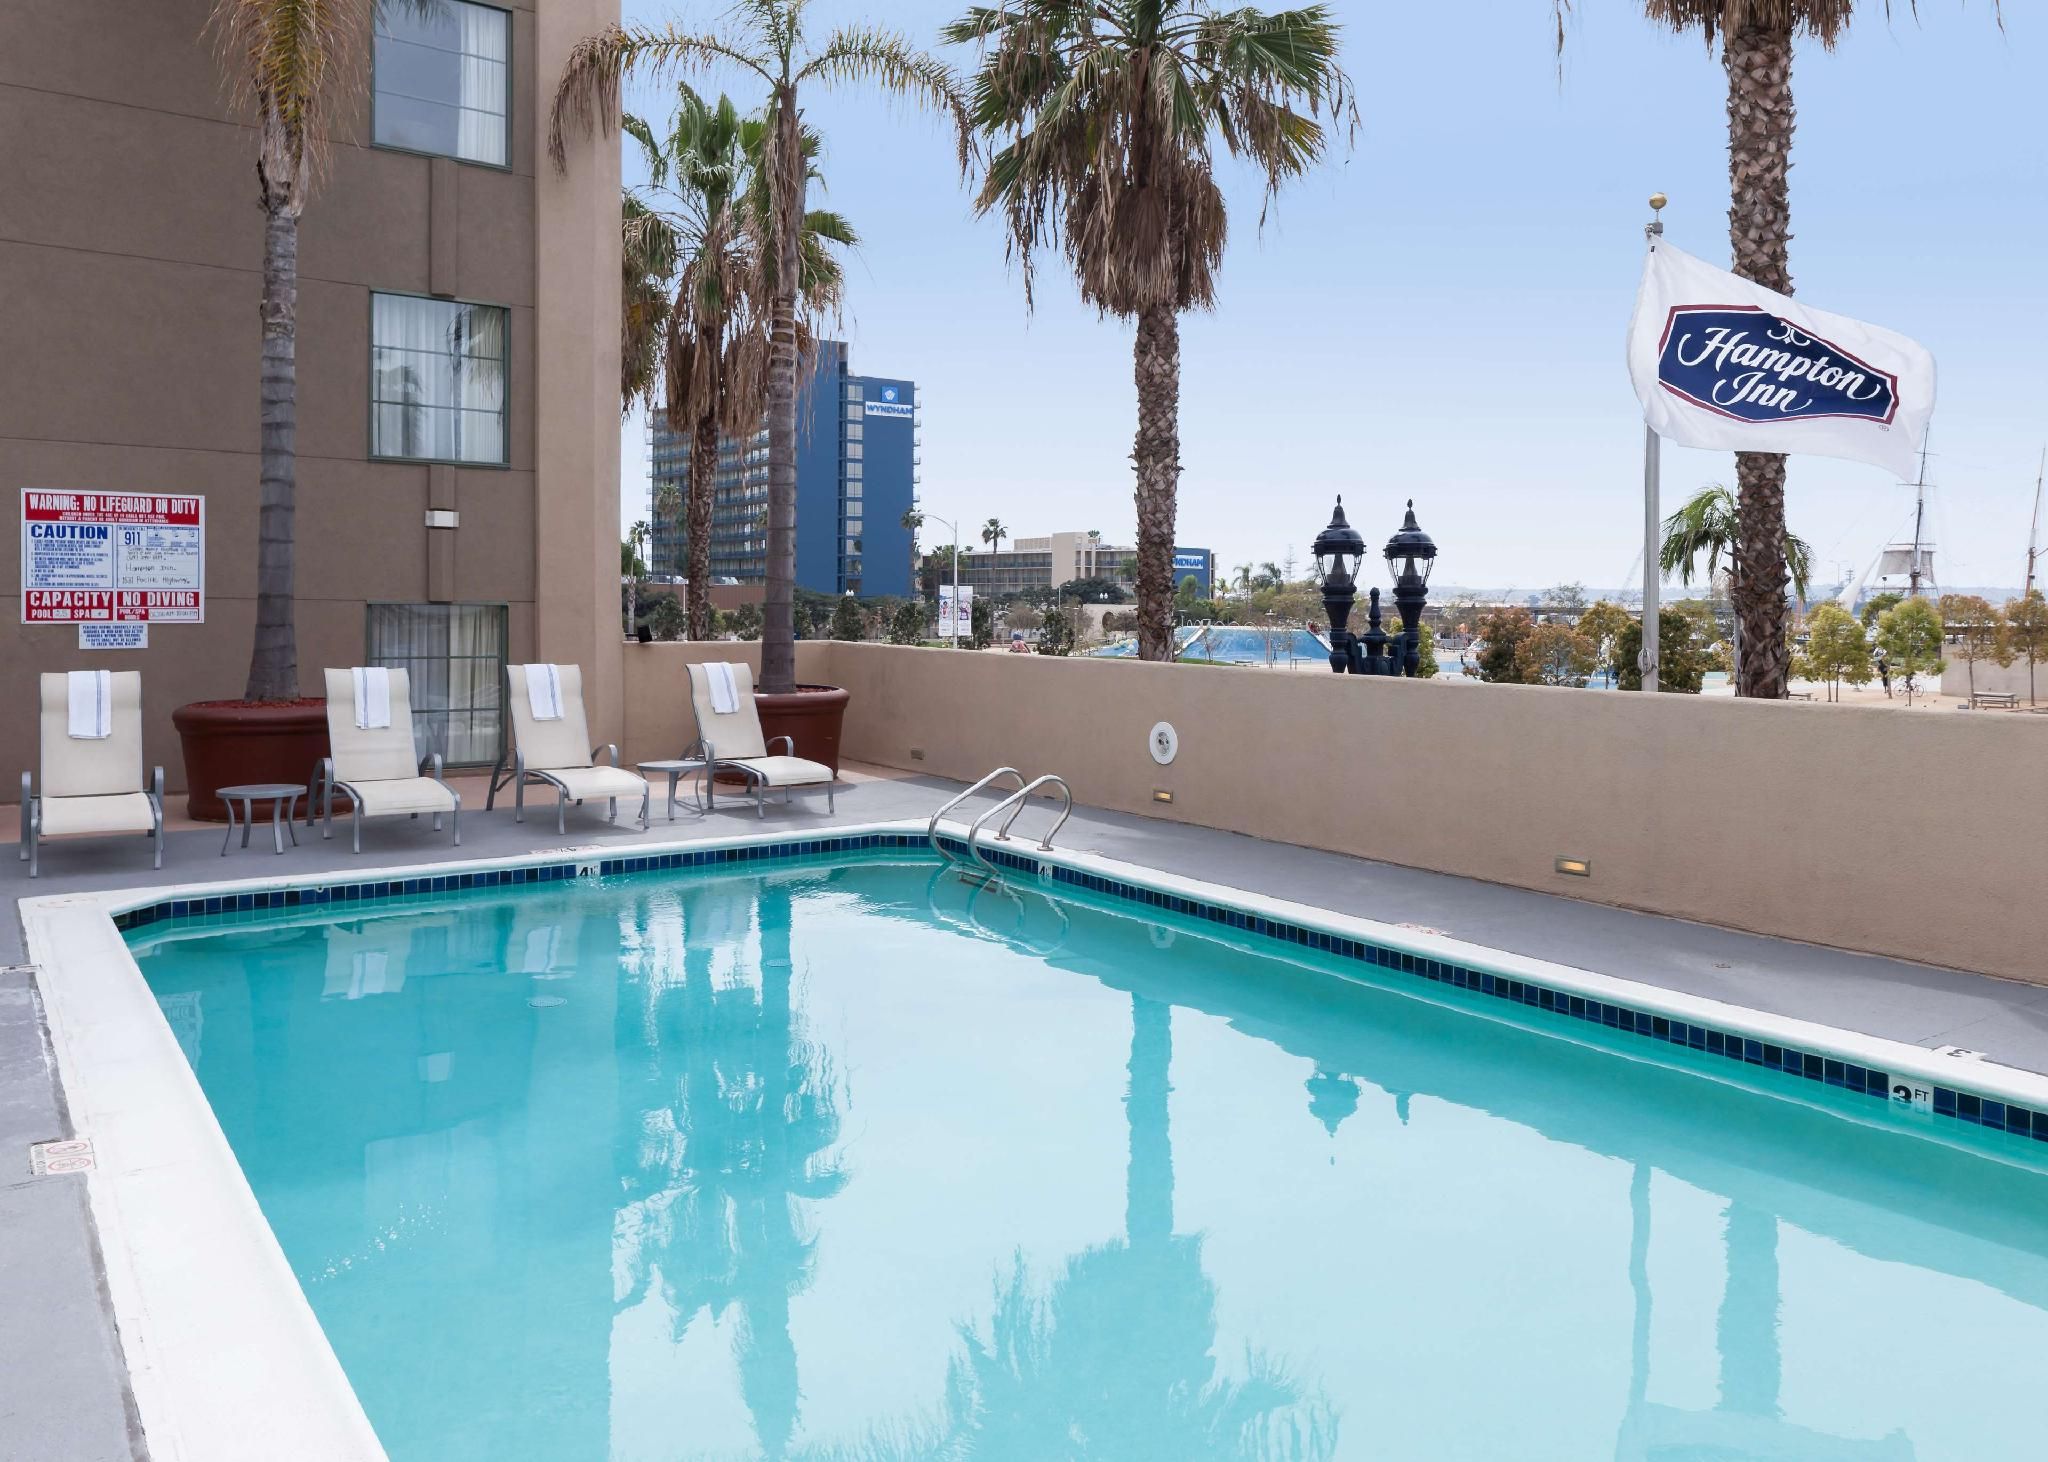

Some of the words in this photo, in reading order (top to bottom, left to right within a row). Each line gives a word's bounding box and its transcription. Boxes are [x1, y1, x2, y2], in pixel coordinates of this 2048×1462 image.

[1678, 327, 1881, 400] Hampton
[1713, 372, 1812, 412] Inn
[867, 404, 912, 415] WYNDHAM
[29, 494, 80, 511] WARNING:
[84, 496, 96, 511] NO
[101, 497, 152, 513] LIFEGUARD
[156, 498, 168, 514] ON
[172, 499, 196, 515] DUTY
[31, 524, 108, 539] CAUTION
[124, 531, 141, 545] 911
[30, 592, 111, 607] CAPACITY
[123, 592, 140, 606] NO
[147, 592, 195, 606] DIVING
[31, 609, 53, 618] POOL
[74, 609, 90, 618] SPA
[1915, 1088, 1929, 1102] FT
